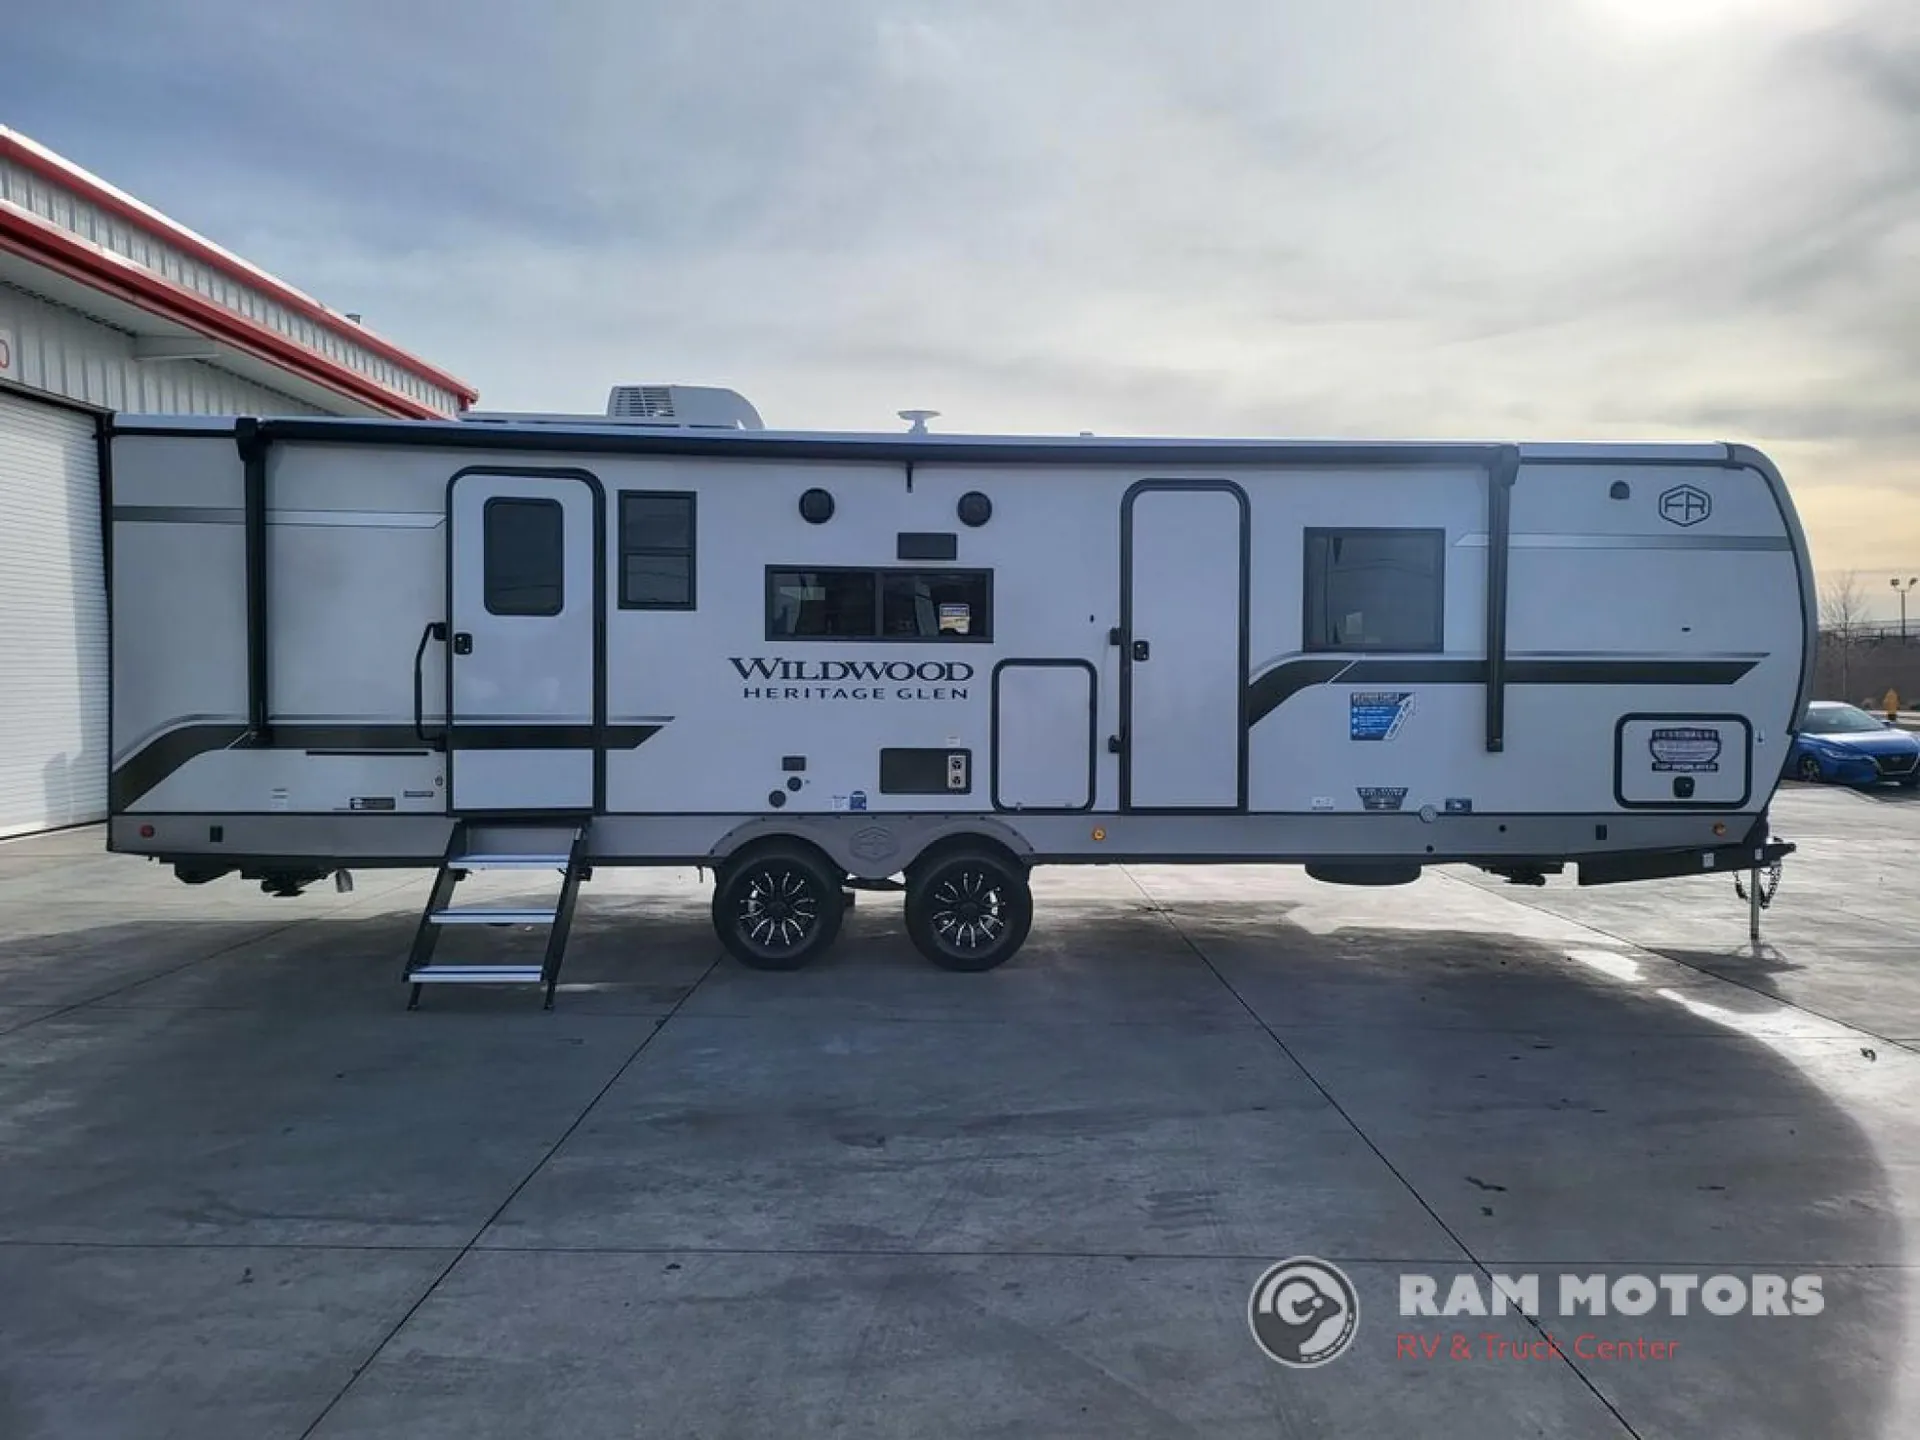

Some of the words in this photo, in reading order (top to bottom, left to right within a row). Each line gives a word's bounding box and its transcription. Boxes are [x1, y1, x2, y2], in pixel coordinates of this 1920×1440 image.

[728, 657, 975, 682] WILDWOOD
[743, 687, 886, 700] HERITAGE
[896, 687, 969, 700] GLEN
